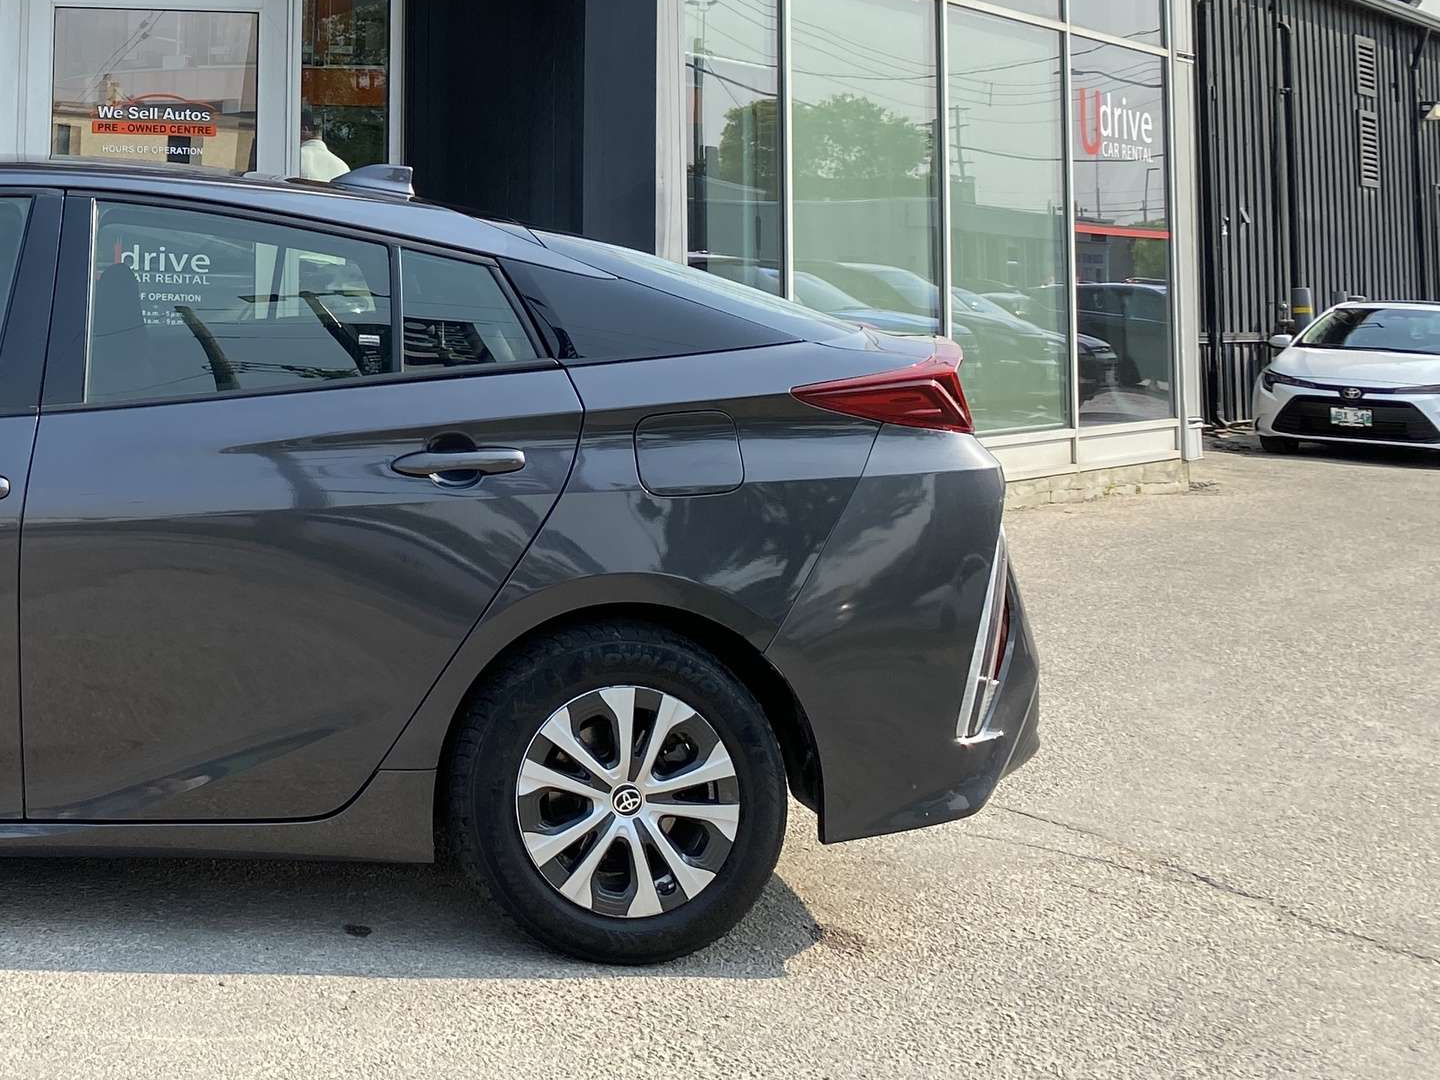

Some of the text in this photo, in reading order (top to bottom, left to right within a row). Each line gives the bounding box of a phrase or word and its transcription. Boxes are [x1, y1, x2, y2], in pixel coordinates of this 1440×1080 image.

[97, 104, 211, 122] We Sell Autos
[97, 123, 119, 132] PRE
[127, 124, 167, 134] OWNED
[169, 125, 211, 135] CENTRE
[102, 144, 203, 156] HOURS OF OPERATION
[1102, 141, 1154, 163] CAR RENTAL
[114, 242, 211, 273] drive
[155, 273, 211, 285] RENTAL
[148, 292, 201, 302] OPERATION
